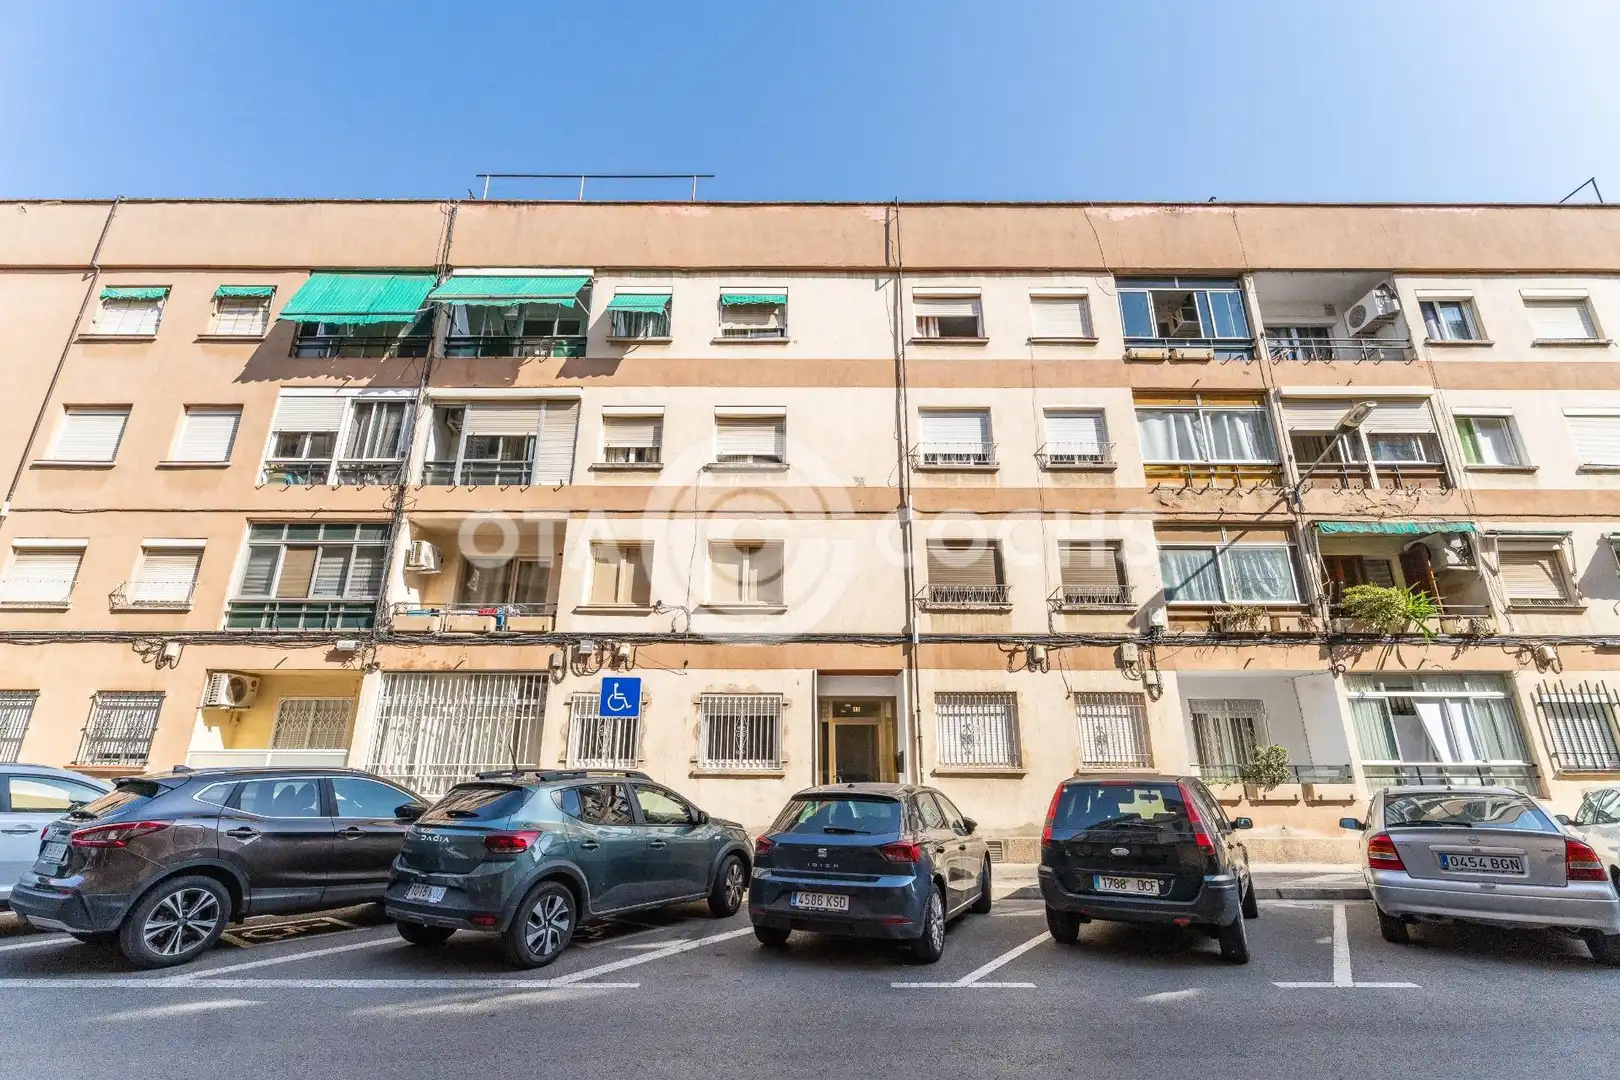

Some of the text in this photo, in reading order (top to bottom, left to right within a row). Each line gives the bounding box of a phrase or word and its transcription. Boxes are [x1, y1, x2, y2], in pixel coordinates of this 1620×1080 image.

[1450, 856, 1520, 870] 0454 BGN
[1102, 877, 1156, 891] 1788 DCF
[799, 893, 846, 908] 4586 KSD
